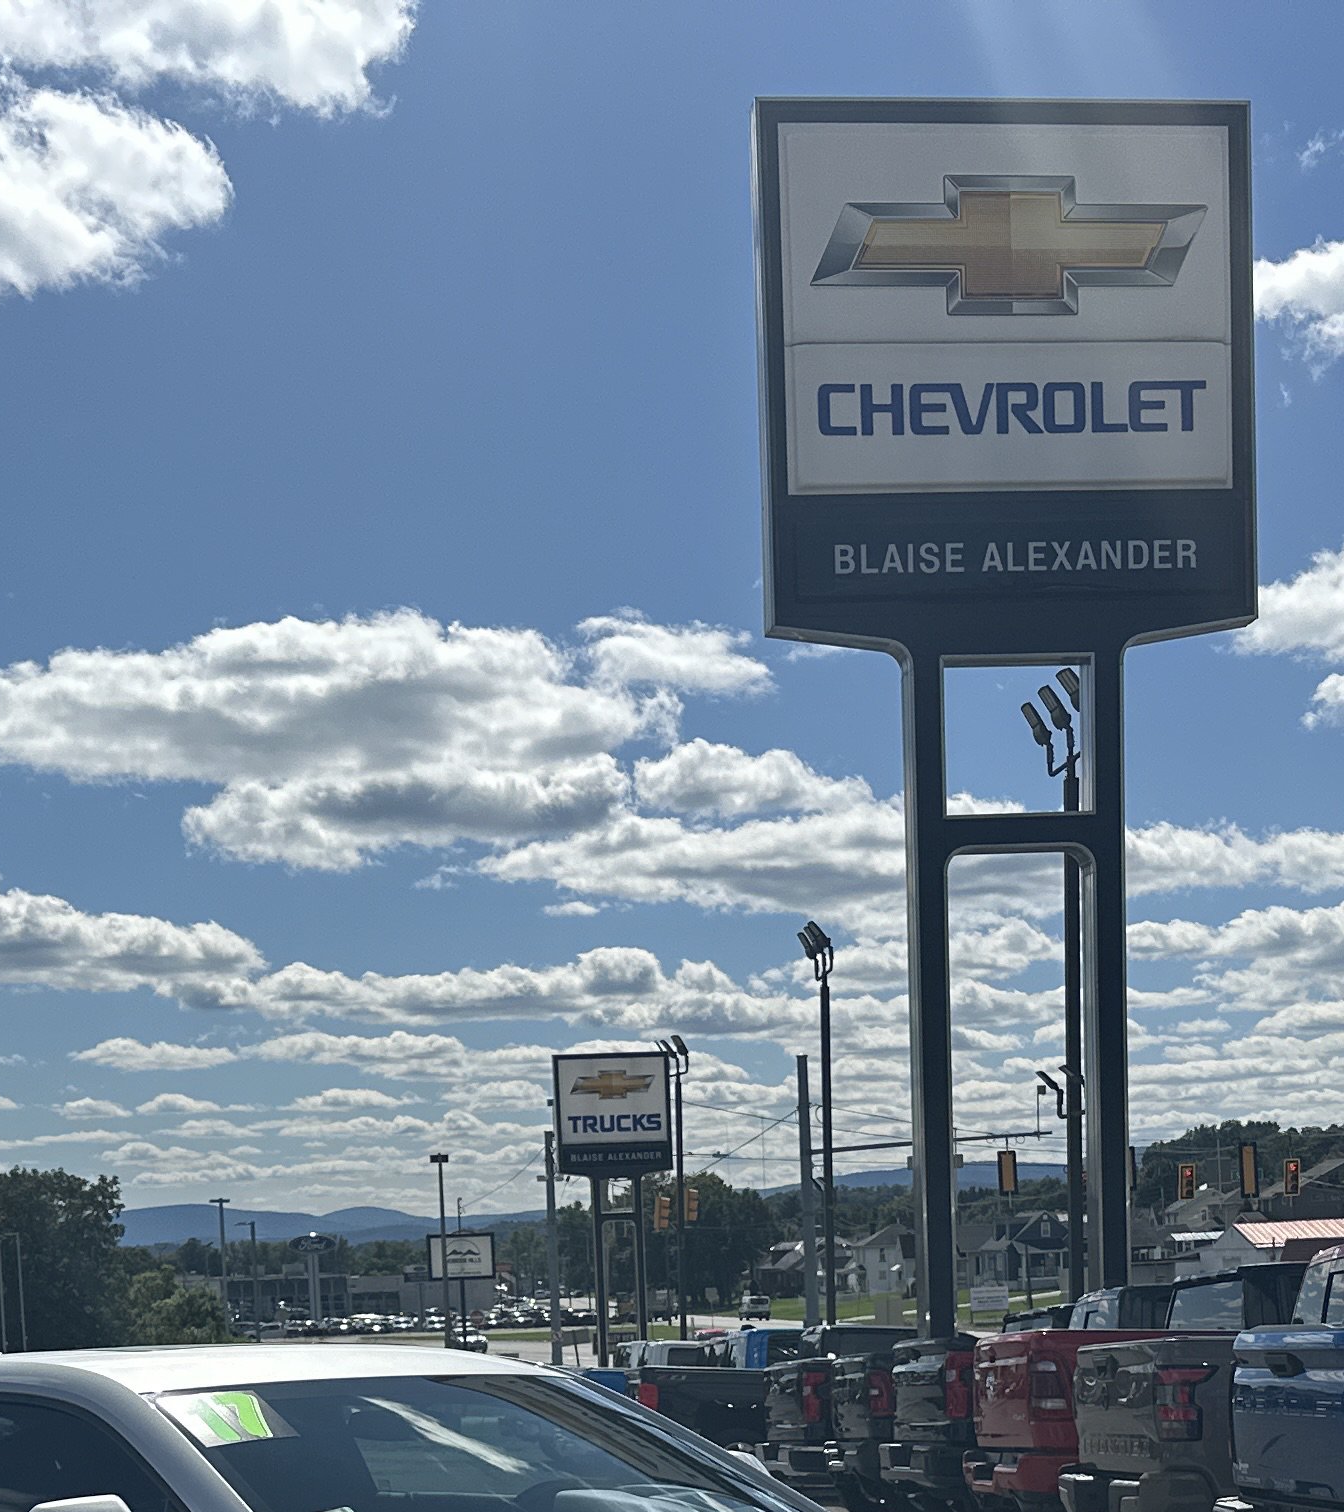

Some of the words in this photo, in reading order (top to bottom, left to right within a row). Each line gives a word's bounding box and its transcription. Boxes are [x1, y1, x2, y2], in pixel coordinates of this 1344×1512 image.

[817, 379, 1207, 437] CHEVROLET
[833, 542, 966, 576] BLAISE
[981, 538, 1198, 573] ALEXANDER
[567, 1113, 662, 1134] TRUCKS
[570, 1153, 604, 1161] BLAISE
[607, 1151, 662, 1160] ALEXANDER
[188, 1391, 274, 1441] 17
